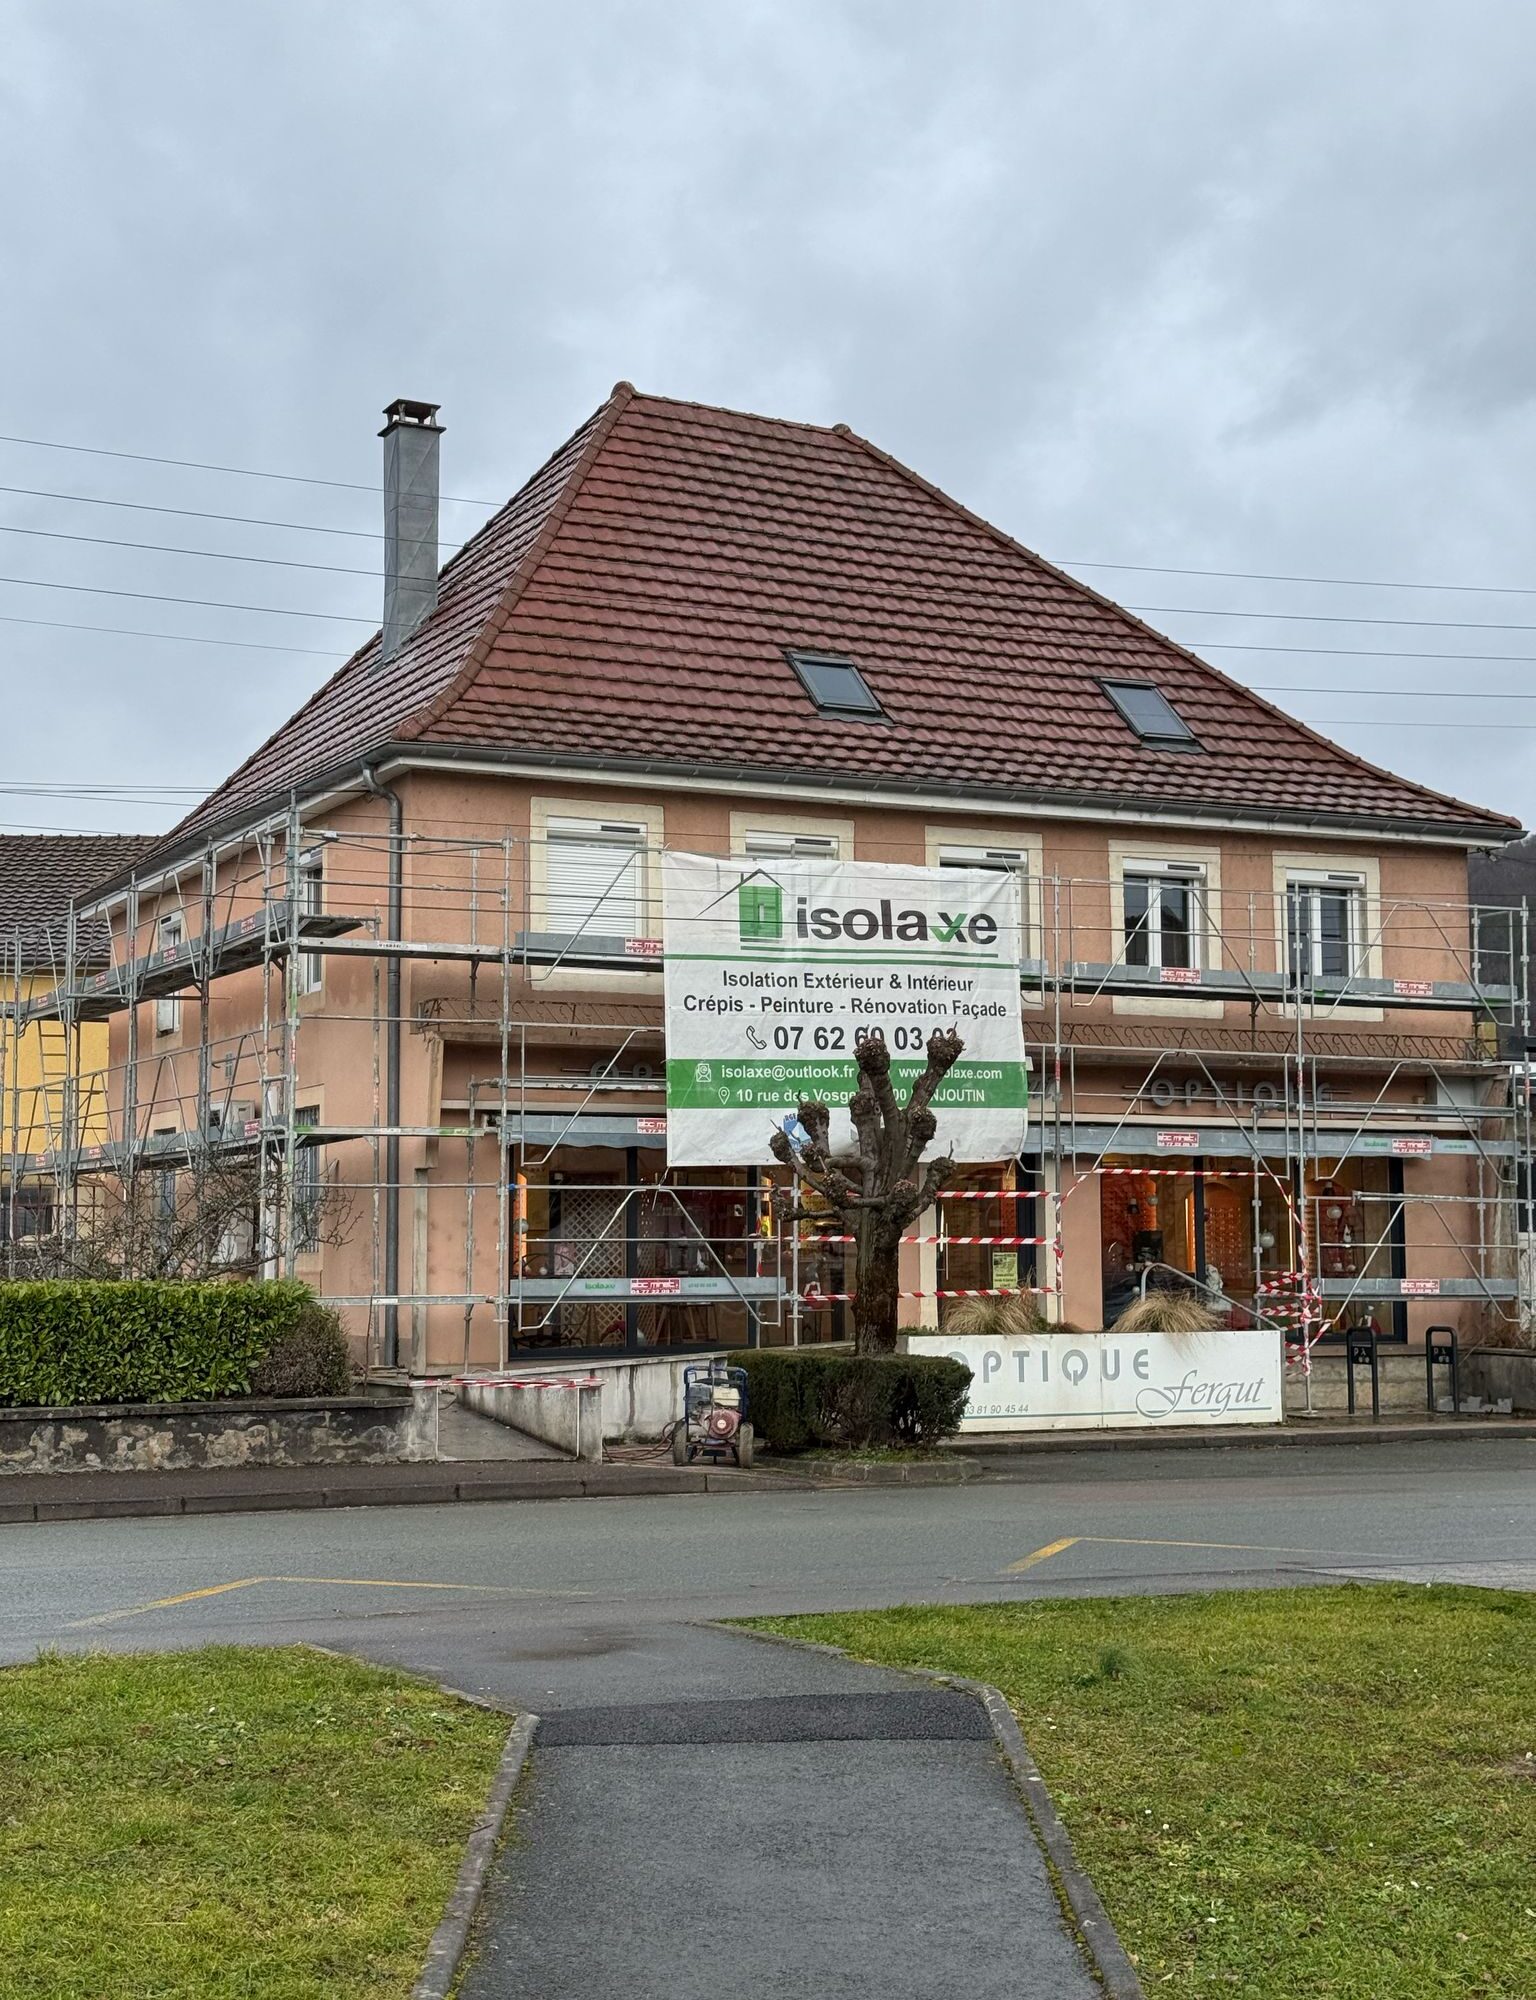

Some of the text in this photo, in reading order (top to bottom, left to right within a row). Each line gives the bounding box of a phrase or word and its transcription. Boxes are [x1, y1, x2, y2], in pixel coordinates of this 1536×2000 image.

[797, 897, 998, 944] isolaxe
[723, 970, 973, 992] Isolation Extérieur & Intérieur
[683, 995, 744, 1015] Crépis
[761, 996, 834, 1014] Peinture
[851, 998, 947, 1015] Rénovation
[953, 1000, 1007, 1020] Façade
[774, 1026, 804, 1050] 07
[814, 1026, 846, 1050] 62
[894, 1026, 923, 1051] 03
[721, 1065, 1002, 1081] isolaxe@outlook.fr wwwolaxe.com
[737, 1089, 752, 1102] 10
[758, 1090, 779, 1101] rue
[784, 1088, 808, 1102] des
[977, 1406, 987, 1414] 81
[991, 1405, 1001, 1413] 90
[1005, 1405, 1015, 1413] 45
[1018, 1404, 1028, 1412] 44
